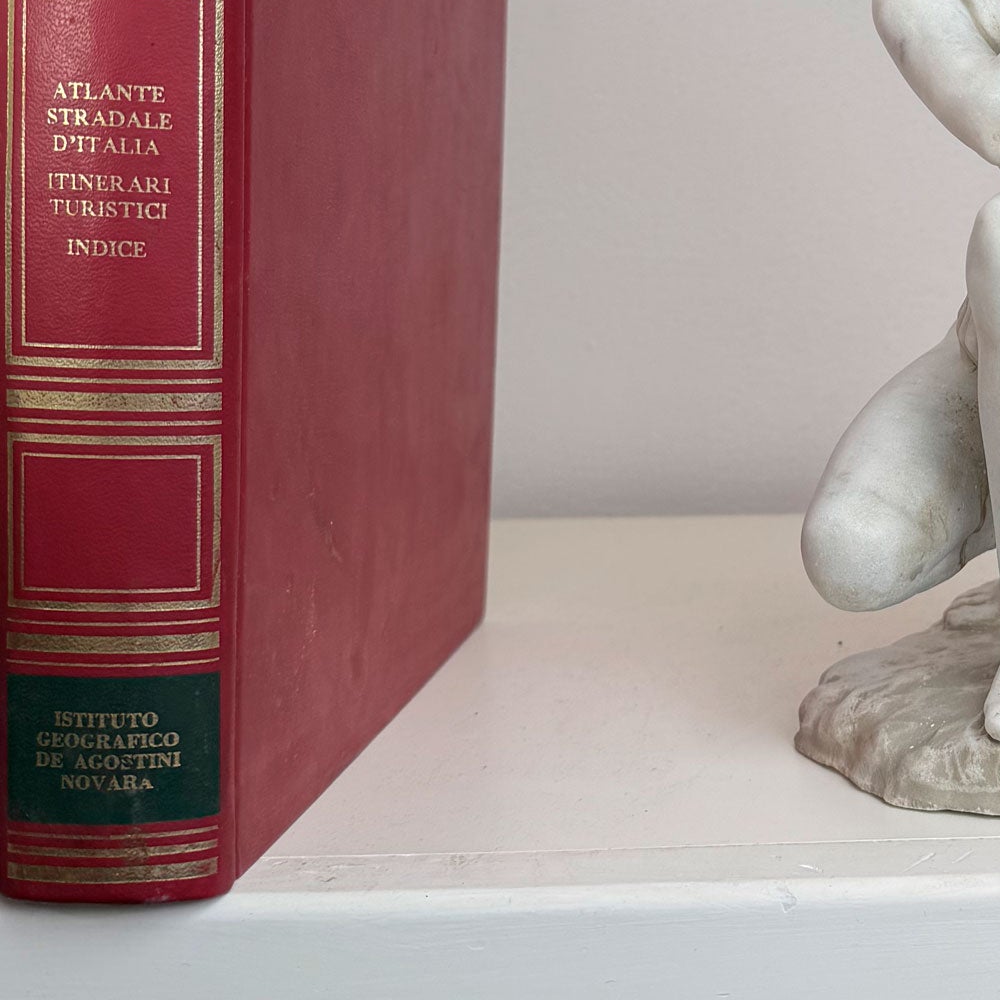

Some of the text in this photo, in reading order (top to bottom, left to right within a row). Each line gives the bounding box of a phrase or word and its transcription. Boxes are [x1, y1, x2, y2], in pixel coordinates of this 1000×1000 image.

[53, 82, 165, 103] ATLANTE
[47, 108, 173, 130] STRADALE
[53, 134, 160, 156] D'ITALIA
[48, 173, 171, 194] ITINERARI
[49, 199, 167, 220] TURISTICI
[67, 239, 147, 258] INDICE
[54, 711, 159, 728] ISTITUTO
[36, 731, 180, 750] GEOGRAFICO
[35, 751, 182, 771] DE AGOSTINI
[61, 774, 154, 791] NOVARA
